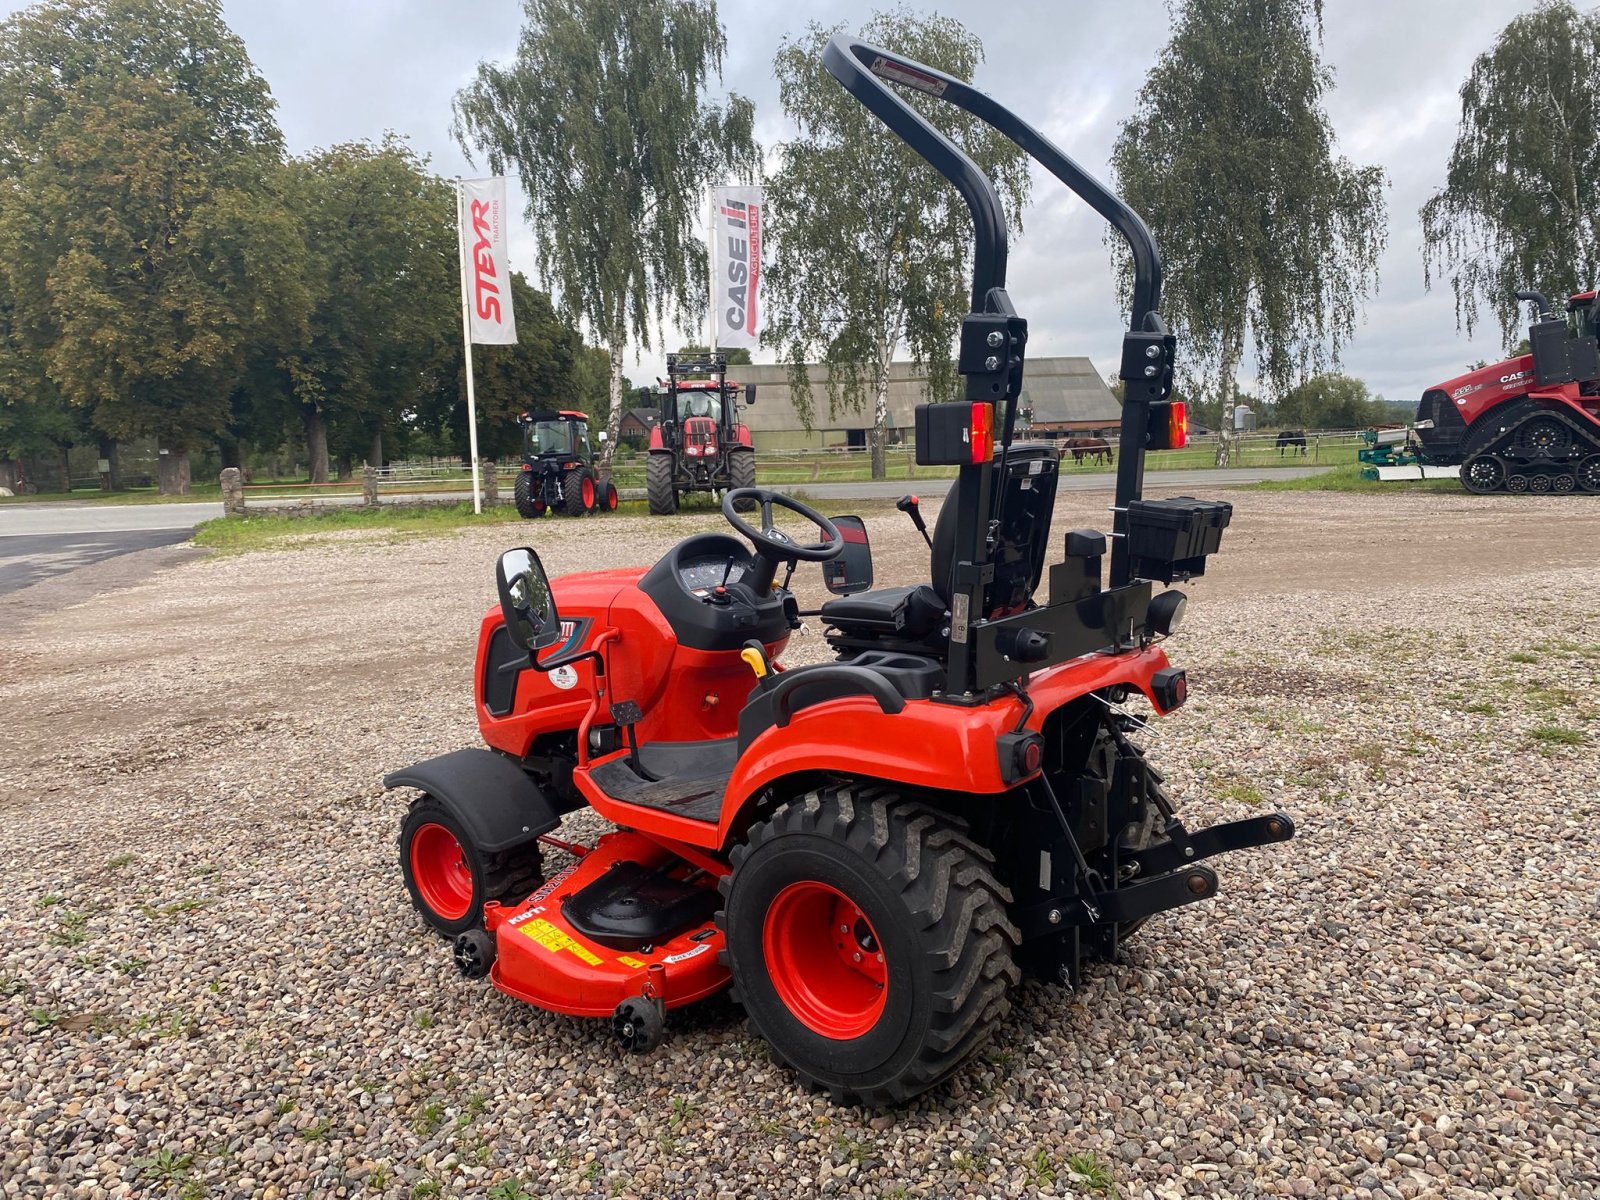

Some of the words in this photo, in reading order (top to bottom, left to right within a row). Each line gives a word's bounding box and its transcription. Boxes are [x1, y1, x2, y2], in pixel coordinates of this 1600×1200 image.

[471, 199, 501, 325] STEYR
[750, 208, 758, 276] AGRICULTURE
[726, 236, 748, 331] CASE
[508, 906, 547, 925] KIOTI
